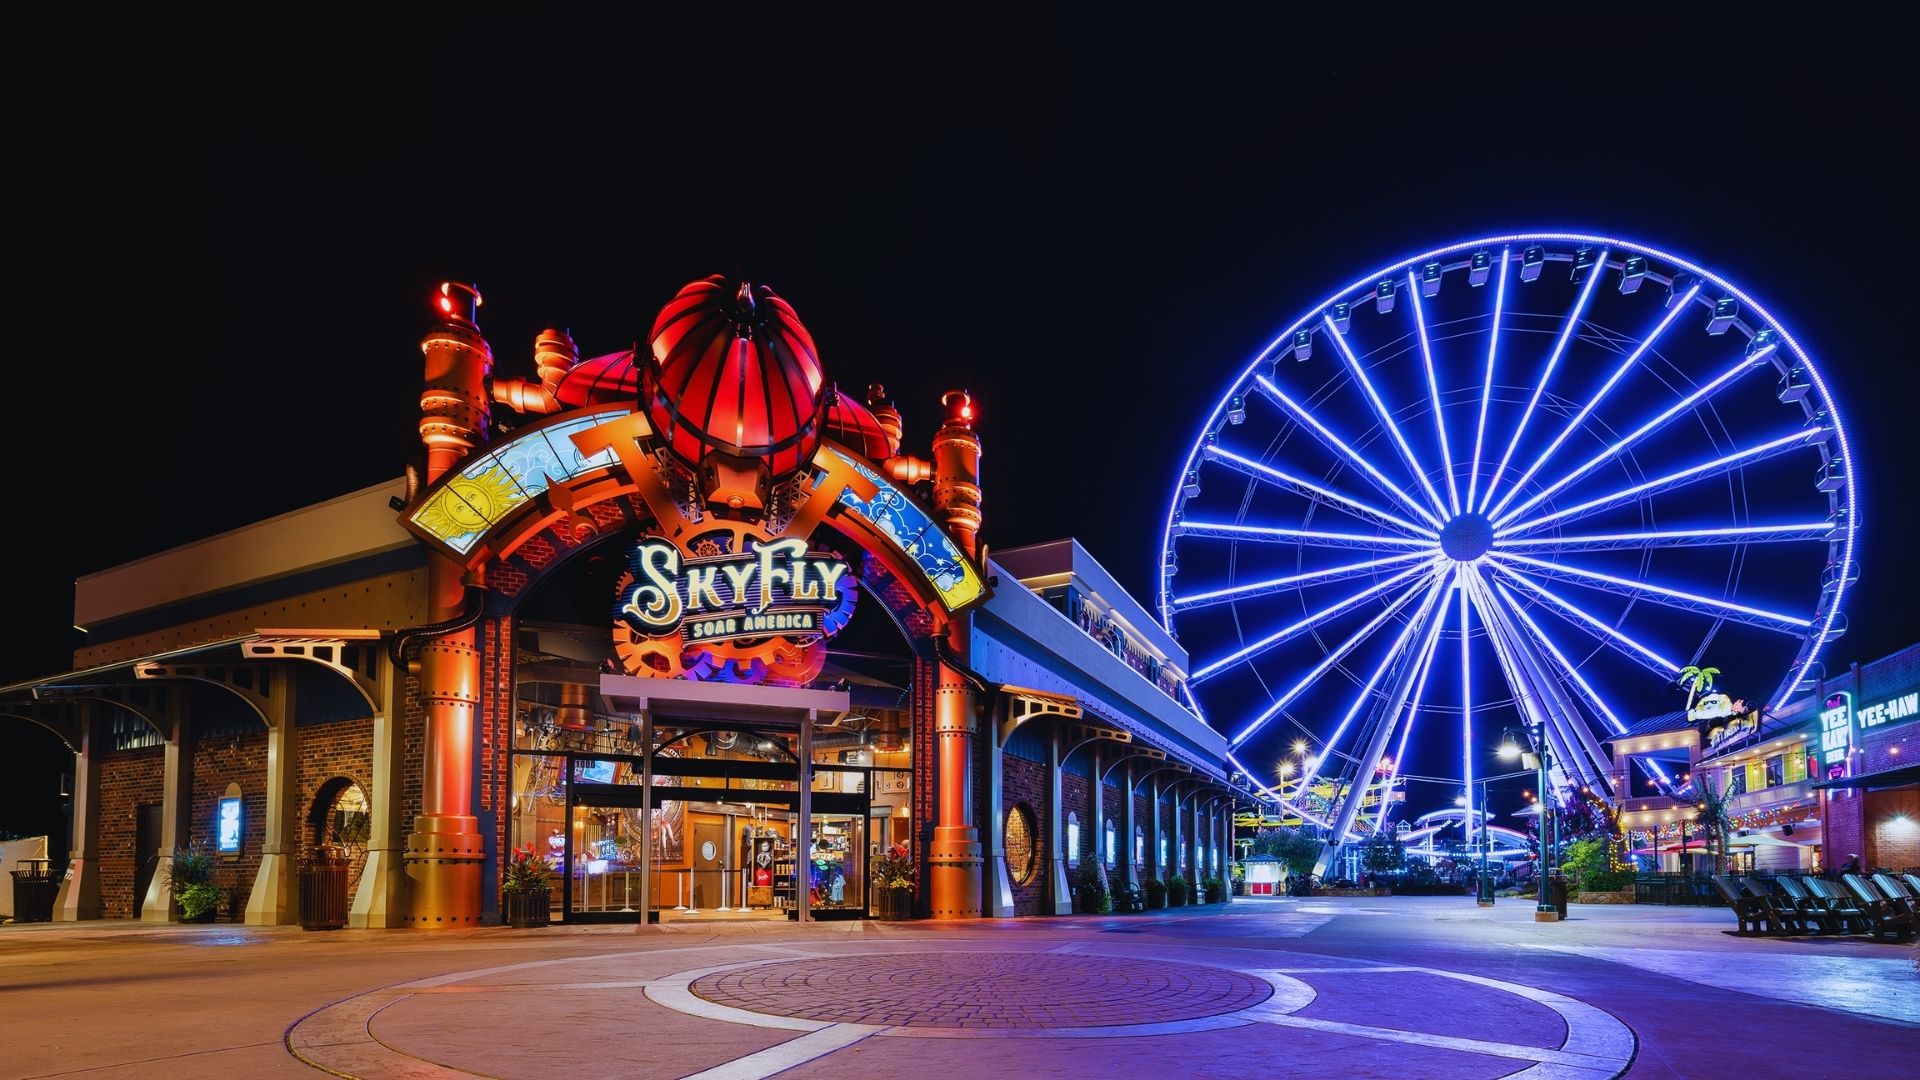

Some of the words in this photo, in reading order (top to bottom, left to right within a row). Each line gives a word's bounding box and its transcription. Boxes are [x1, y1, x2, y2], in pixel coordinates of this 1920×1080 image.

[693, 619, 736, 638] SOAR
[743, 614, 812, 631] AMERICA
[1820, 705, 1848, 731] YEE
[1857, 693, 1918, 728] YEE-HAW
[1822, 725, 1848, 751] HAW
